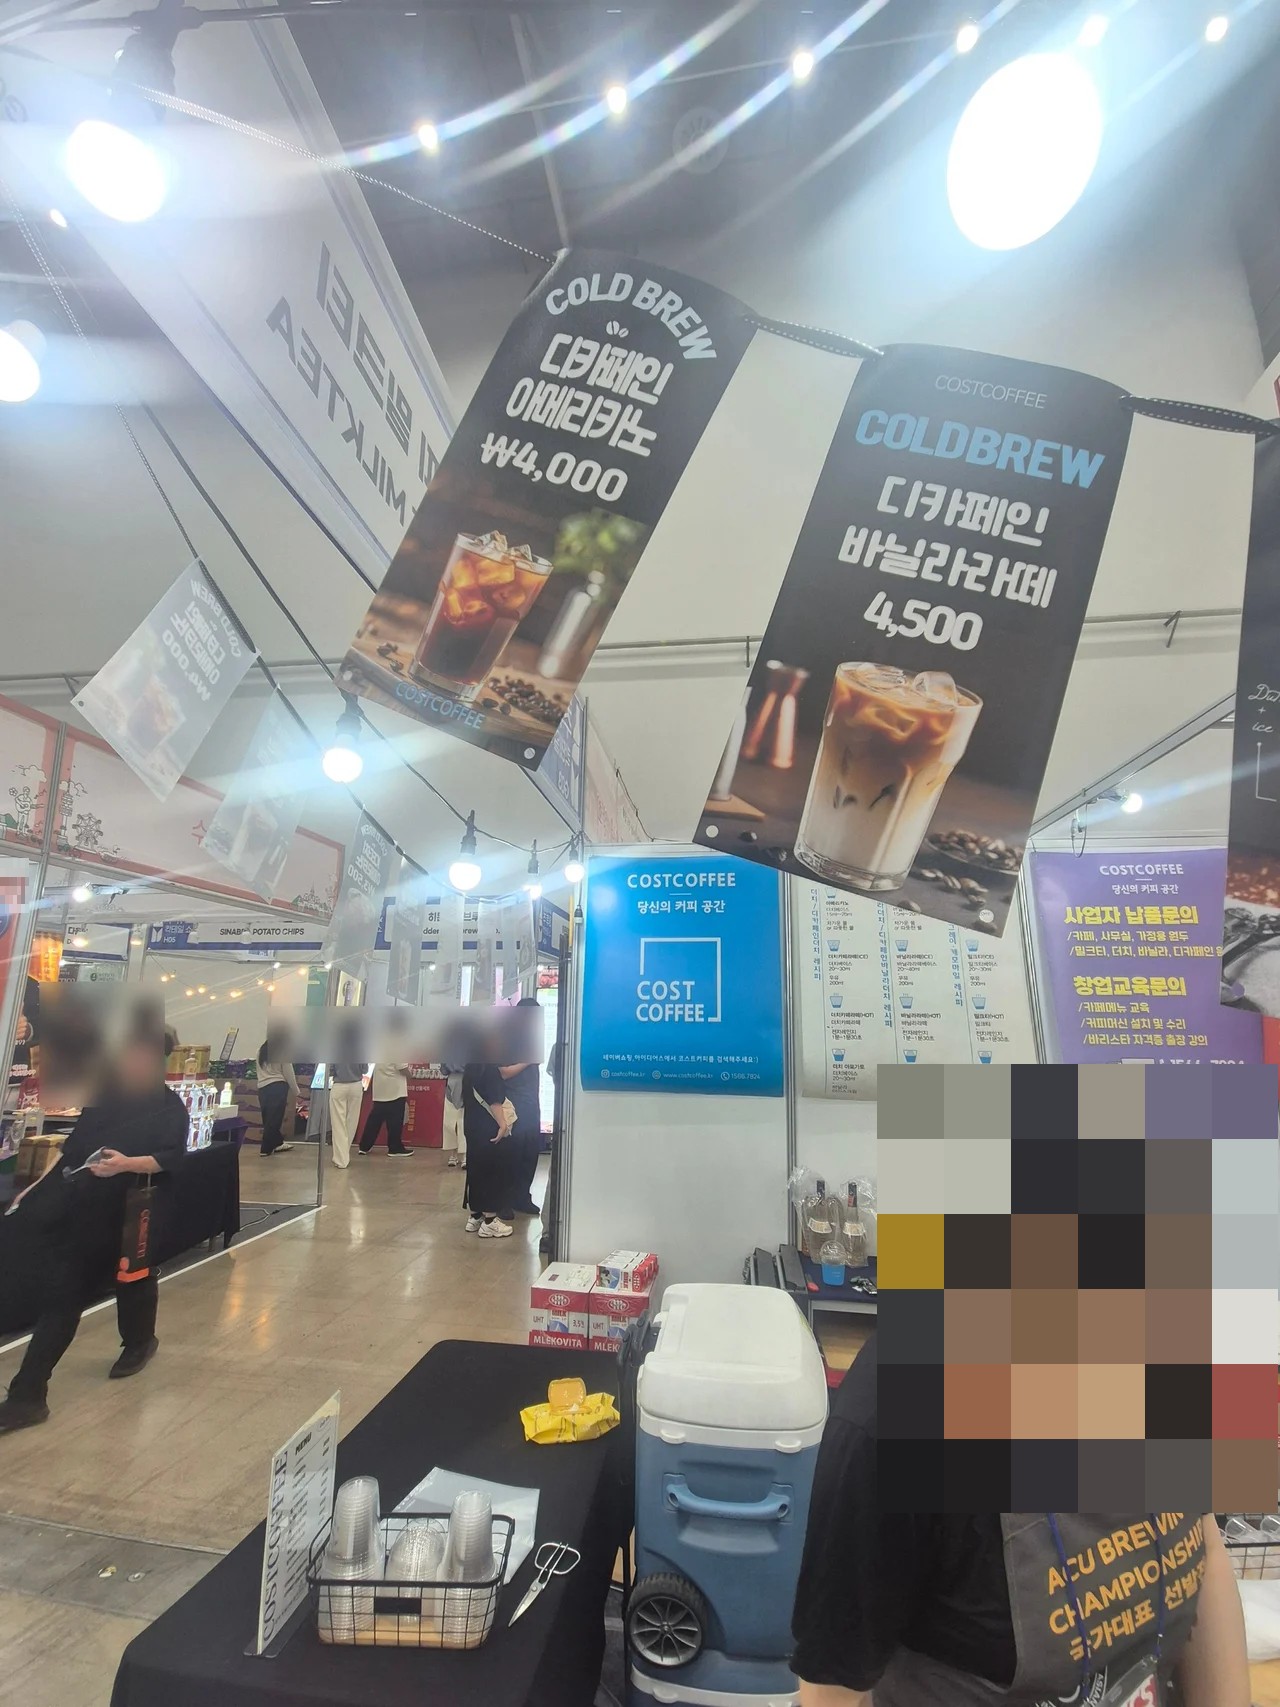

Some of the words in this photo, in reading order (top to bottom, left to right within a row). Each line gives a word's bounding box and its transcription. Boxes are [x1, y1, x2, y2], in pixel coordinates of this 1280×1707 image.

[544, 272, 632, 316] COLD
[632, 279, 717, 363] BREW
[934, 374, 1048, 410] COSTCOFFEE
[480, 432, 629, 503] ₩4,000
[876, 474, 1051, 548] 디카페인
[863, 591, 984, 652] 4,500
[395, 681, 487, 730] COSTCOFFEE
[1252, 721, 1274, 733] ice
[1099, 863, 1184, 876] COSTCOFFEE
[627, 872, 736, 888] COSTCOFFEE
[1111, 884, 1138, 895] 당신의
[1141, 884, 1159, 895] 커피
[1161, 884, 1179, 895] 공간
[637, 900, 671, 914] 당신의
[675, 900, 697, 913] 커피
[701, 900, 726, 913] 공간
[1064, 906, 1120, 925] 사업자
[1125, 905, 1199, 925] 납품문의
[252, 928, 280, 936] POTATO
[281, 928, 304, 936] CHIPS
[1101, 930, 1134, 942] 사무실,
[1136, 930, 1166, 942] 가정용
[1169, 931, 1189, 942] 원두
[1112, 946, 1136, 957] 더치,
[1138, 946, 1172, 958] 바닐라,
[1173, 946, 1215, 957] 디카페인
[636, 980, 695, 1001] COST
[1073, 976, 1187, 996] 창업교육문의
[636, 1003, 705, 1023] COFFEE
[1129, 1002, 1150, 1013] 교육
[1130, 1018, 1150, 1029] 설치
[1153, 1018, 1164, 1030] 및
[1166, 1018, 1186, 1029] 수리
[1133, 1034, 1162, 1045] 자격증
[1165, 1034, 1185, 1045] 출장
[1188, 1034, 1208, 1046] 강의
[532, 1315, 545, 1323] UHT
[592, 1322, 605, 1330] UHT
[533, 1335, 582, 1348] MLEKOVITA
[294, 1431, 312, 1456] MENU
[262, 1450, 289, 1642] COSTCOFFEE
